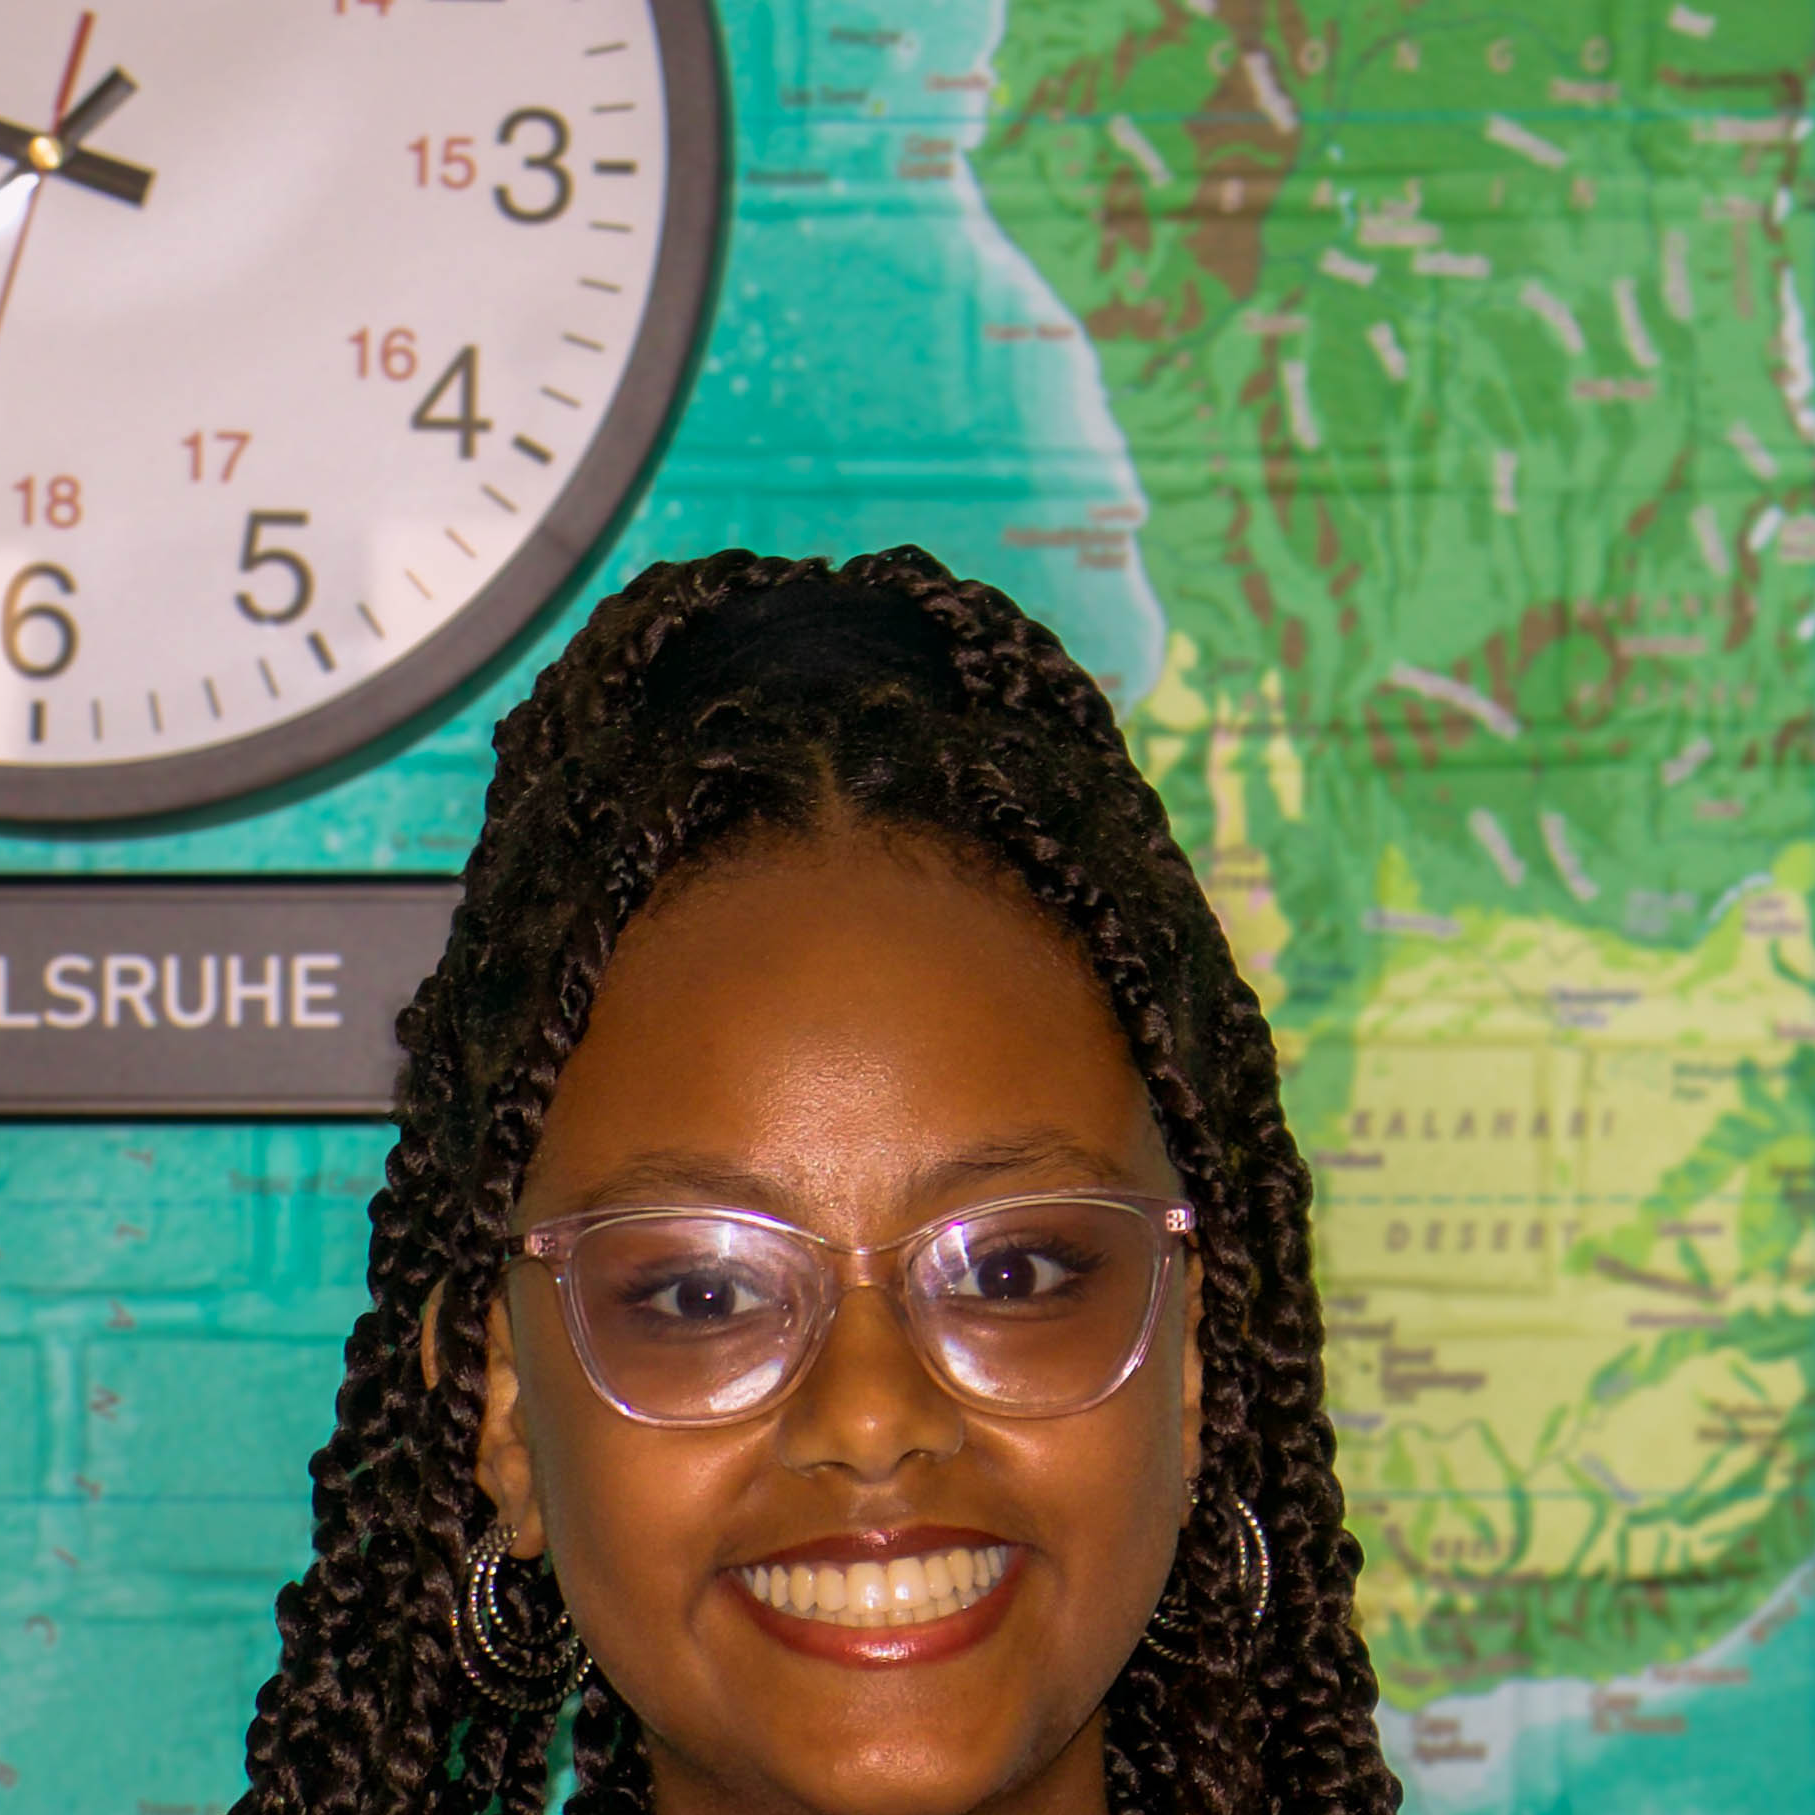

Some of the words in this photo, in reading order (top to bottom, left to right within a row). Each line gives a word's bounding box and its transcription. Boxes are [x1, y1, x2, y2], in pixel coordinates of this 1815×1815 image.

[1207, 36, 1610, 74] CONGO
[408, 135, 478, 192] 15
[493, 105, 574, 226] 3
[349, 327, 419, 382] 16
[410, 344, 493, 461] 4
[183, 429, 252, 484] 17
[14, 474, 82, 531] 18
[234, 509, 315, 626] 5
[3, 561, 80, 682] 6
[1385, 1221, 1583, 1254] DESERT
